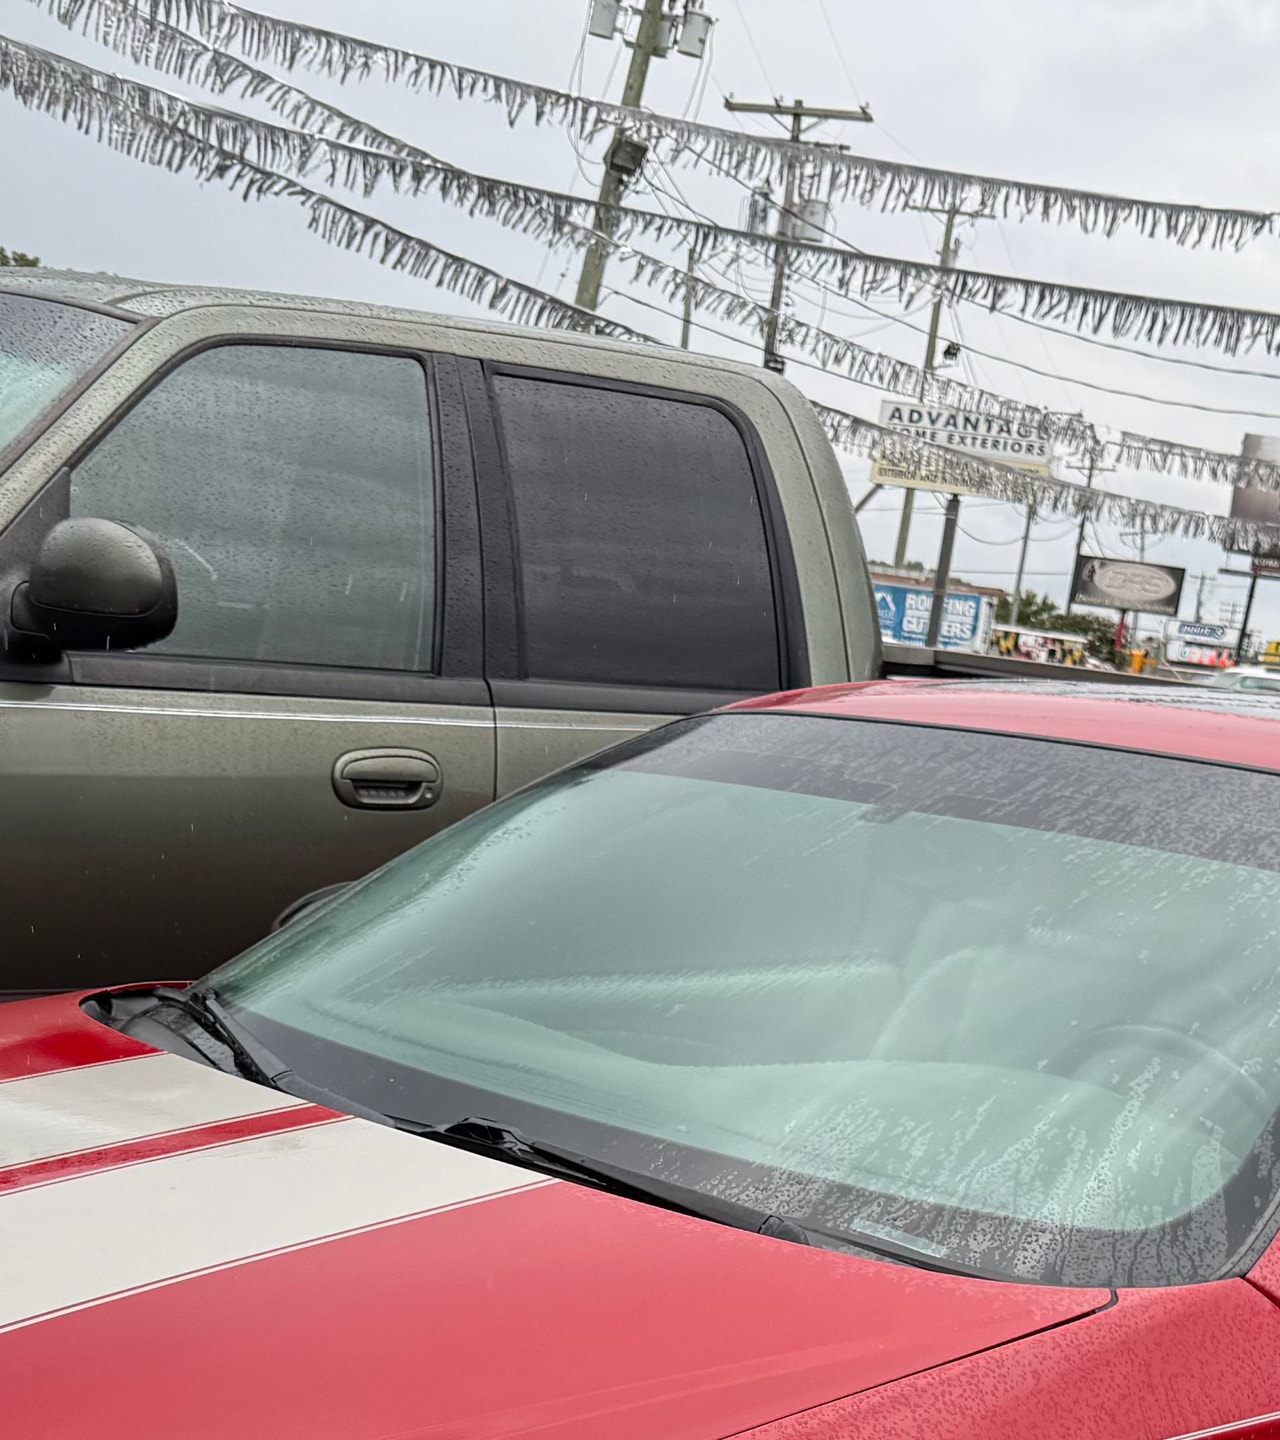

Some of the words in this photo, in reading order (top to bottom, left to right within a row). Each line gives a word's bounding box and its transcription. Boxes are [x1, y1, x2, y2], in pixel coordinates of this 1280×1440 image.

[947, 432, 1047, 458] EXTERIORS
[904, 591, 977, 619] ROING
[901, 616, 973, 638] GUTERS
